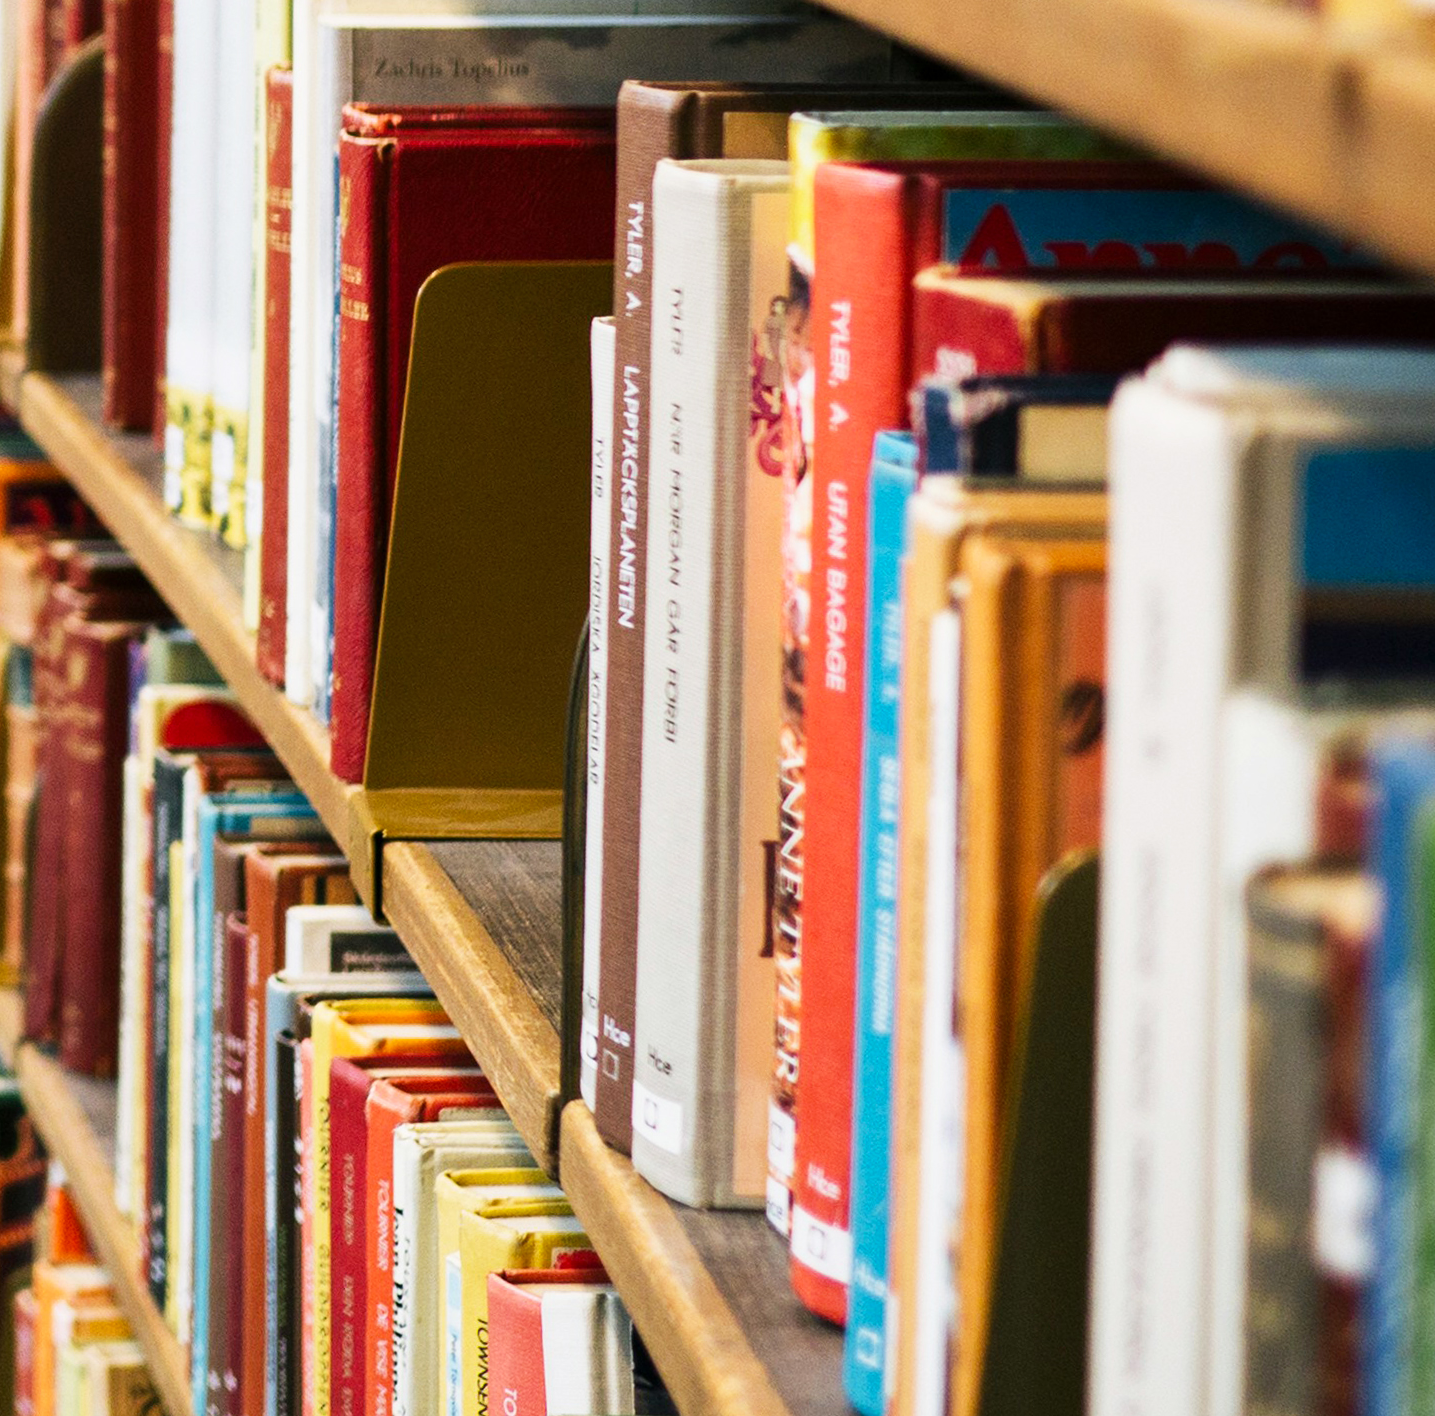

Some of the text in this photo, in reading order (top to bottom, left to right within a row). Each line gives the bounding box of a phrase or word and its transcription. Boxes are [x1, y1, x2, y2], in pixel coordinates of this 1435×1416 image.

[671, 287, 685, 357] TYLER
[617, 201, 645, 630] TYLER, A. LAPPTÄCKSPLANETEN
[667, 468, 684, 587] MORGAN
[824, 300, 852, 693] TYLER, A. UTAN BAGAGE
[666, 598, 683, 653] GÅR
[774, 736, 805, 1085] ANNE TYLER
[604, 1013, 631, 1048] Hce
[647, 1044, 673, 1075] Hce
[318, 1096, 331, 1212] TOURNIER
[376, 1178, 390, 1271] TOURNIER
